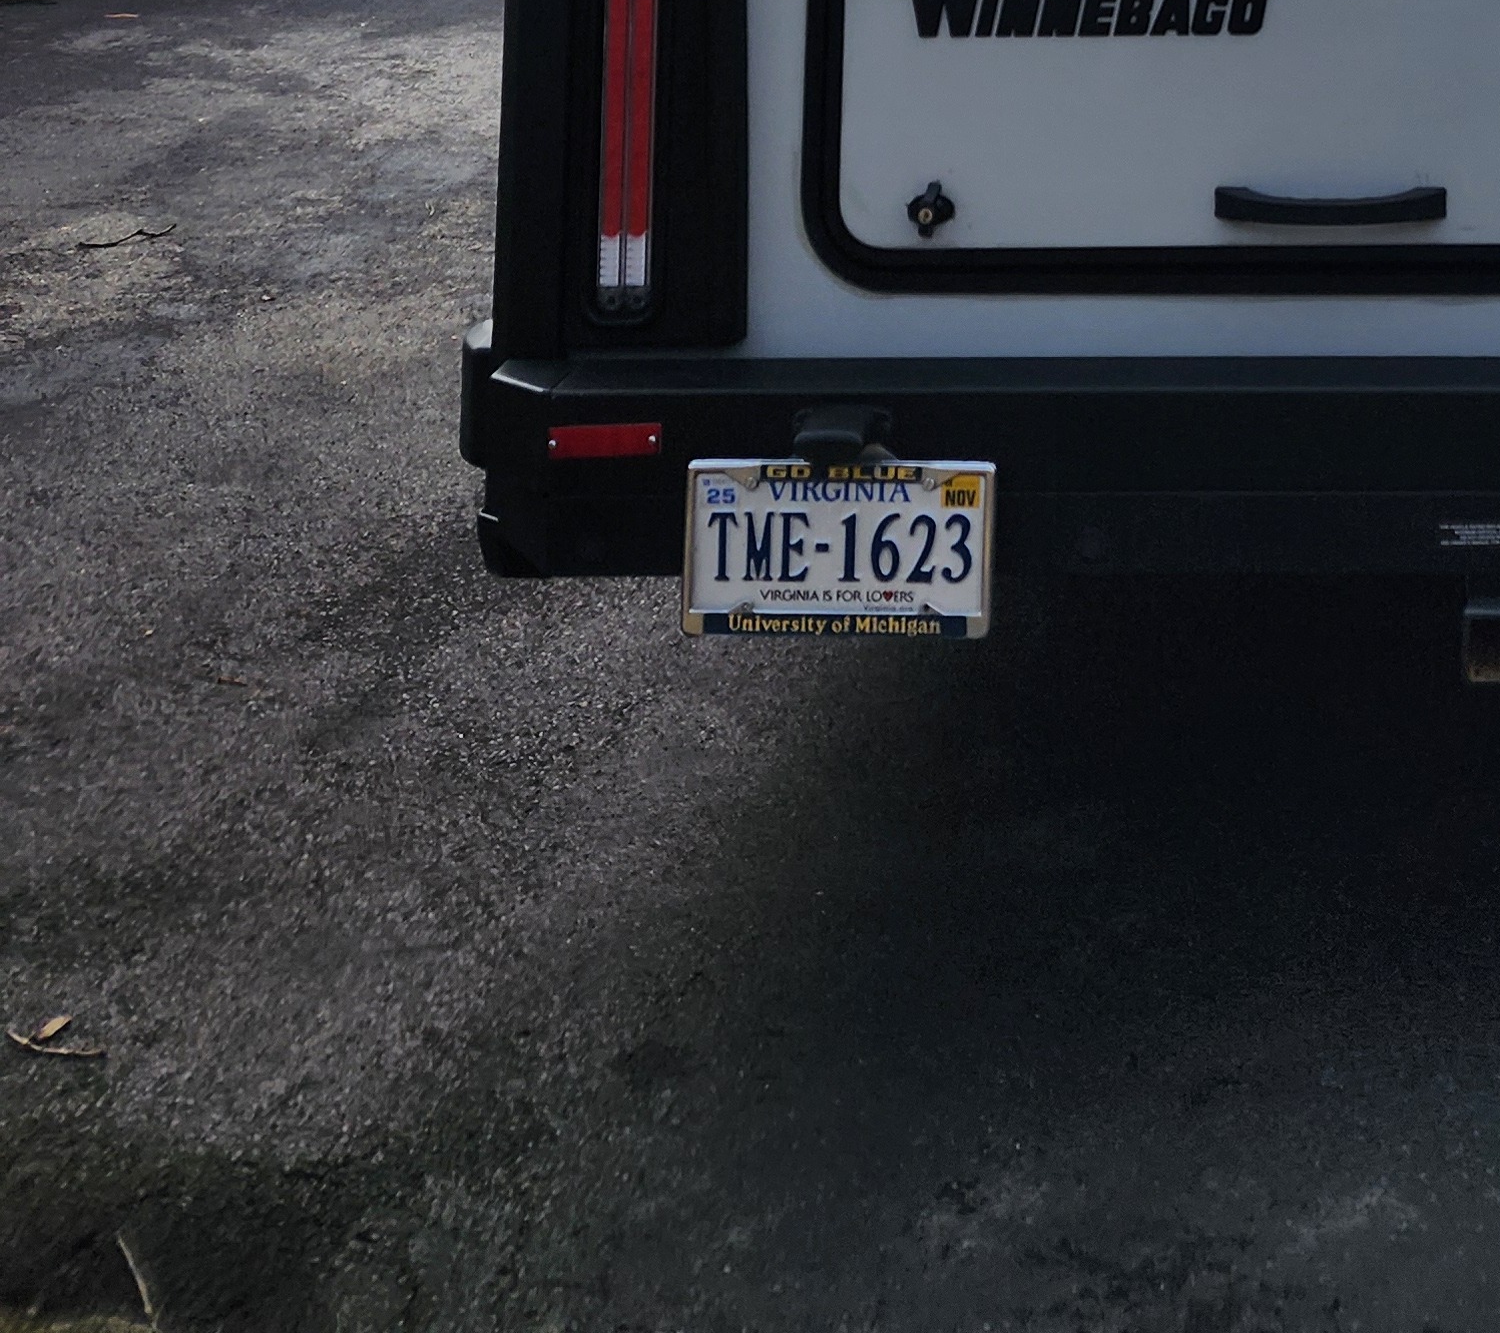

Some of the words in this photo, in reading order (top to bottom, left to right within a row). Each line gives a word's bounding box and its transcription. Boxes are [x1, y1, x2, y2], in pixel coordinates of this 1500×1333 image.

[765, 465, 812, 480] GO
[828, 465, 918, 481] BLUE
[706, 488, 737, 505] 25
[768, 480, 912, 503] VIRGINIA
[945, 489, 976, 507] NOV
[707, 511, 973, 583] TME-1623
[760, 589, 819, 602] VIRGINIA
[822, 589, 833, 601] IS
[836, 589, 862, 603] FOR
[728, 614, 827, 635] University
[831, 616, 851, 633] of
[855, 616, 941, 637] Michigan
